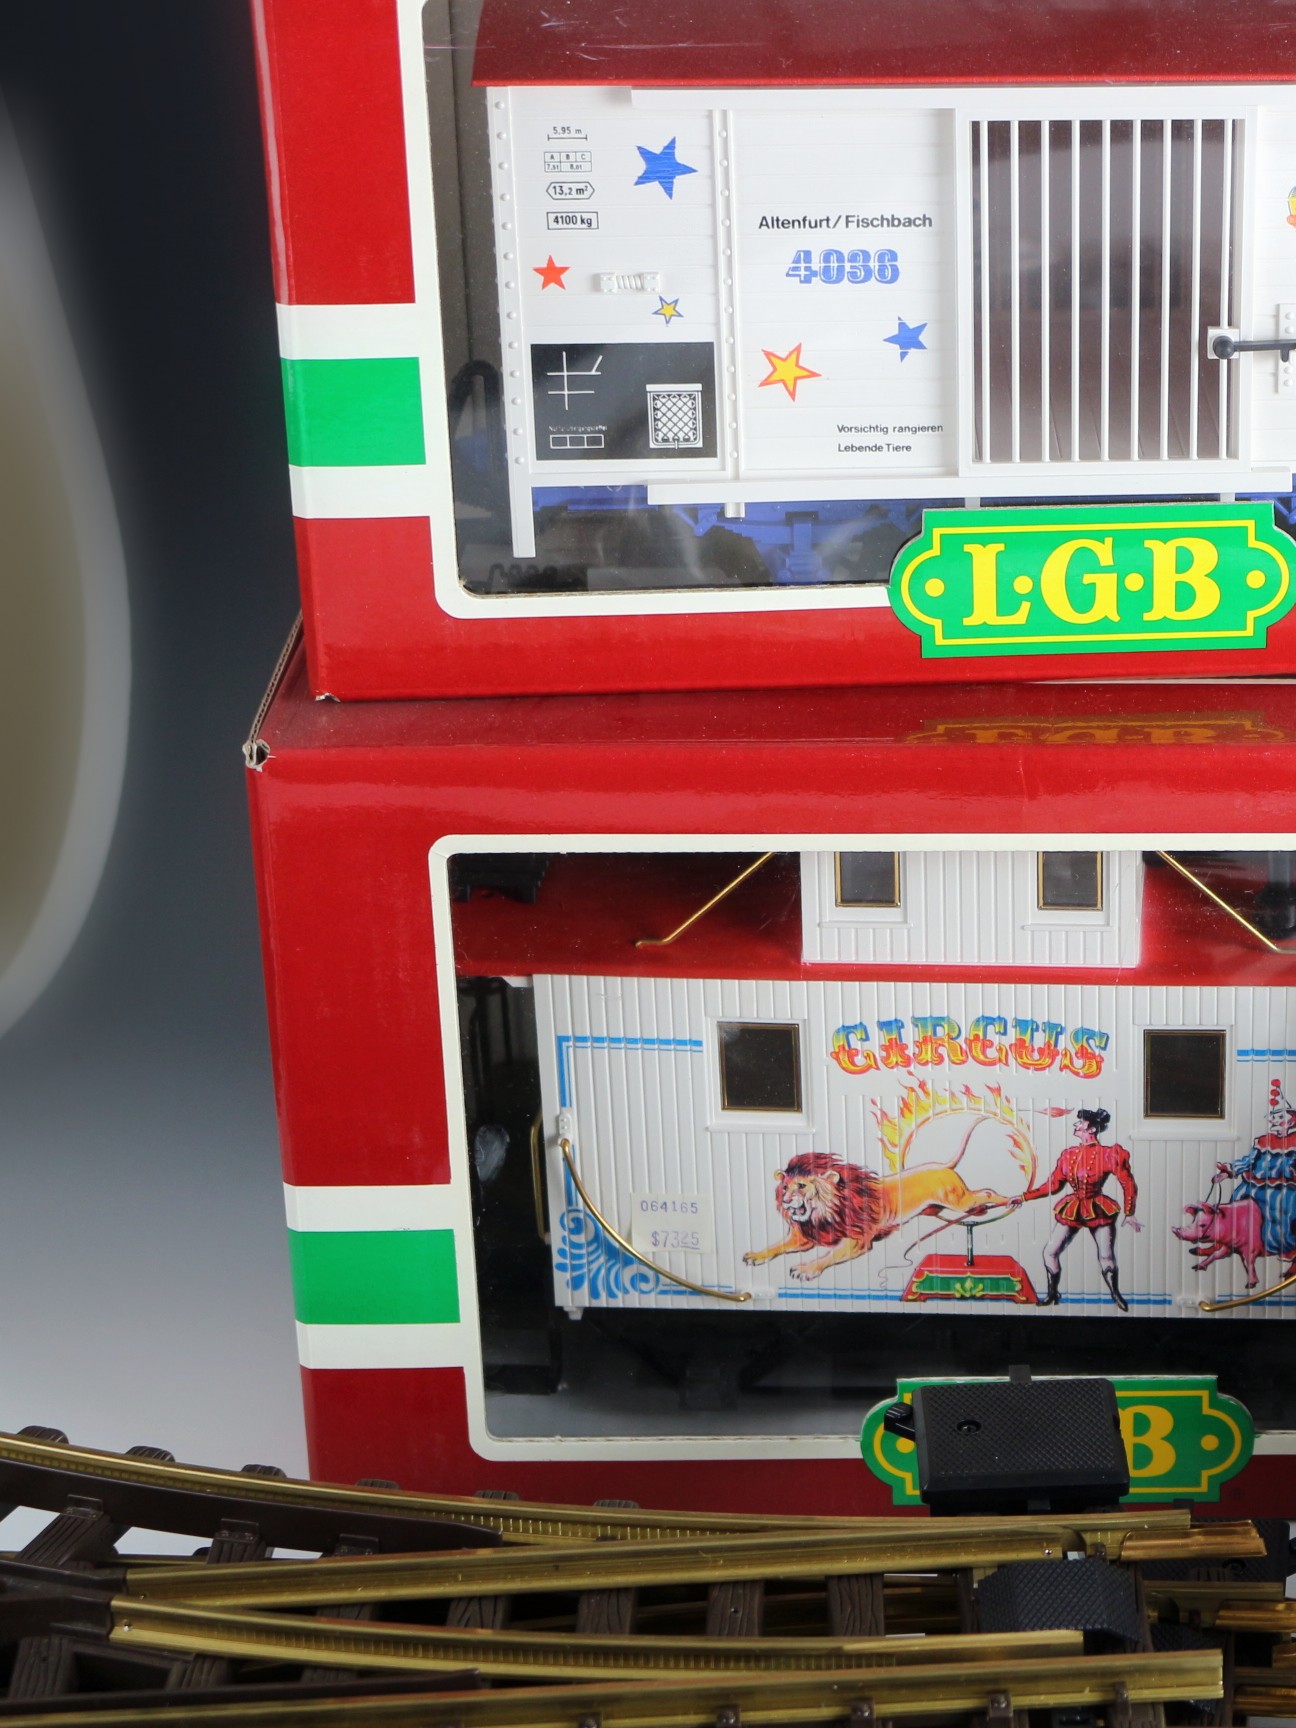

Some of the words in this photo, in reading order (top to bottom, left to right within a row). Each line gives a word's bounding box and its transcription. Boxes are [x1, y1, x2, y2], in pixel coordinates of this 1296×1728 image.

[552, 185, 573, 196] 13,2
[553, 215, 578, 225] 4100
[580, 215, 592, 228] kg
[785, 248, 901, 285] 4036
[837, 424, 888, 435] Vorsichtig
[893, 424, 943, 435] rangieren
[838, 443, 883, 452] Lebende
[885, 443, 911, 452] Tiere
[830, 1015, 1110, 1079] CIRCUS
[640, 1200, 698, 1214] 064165
